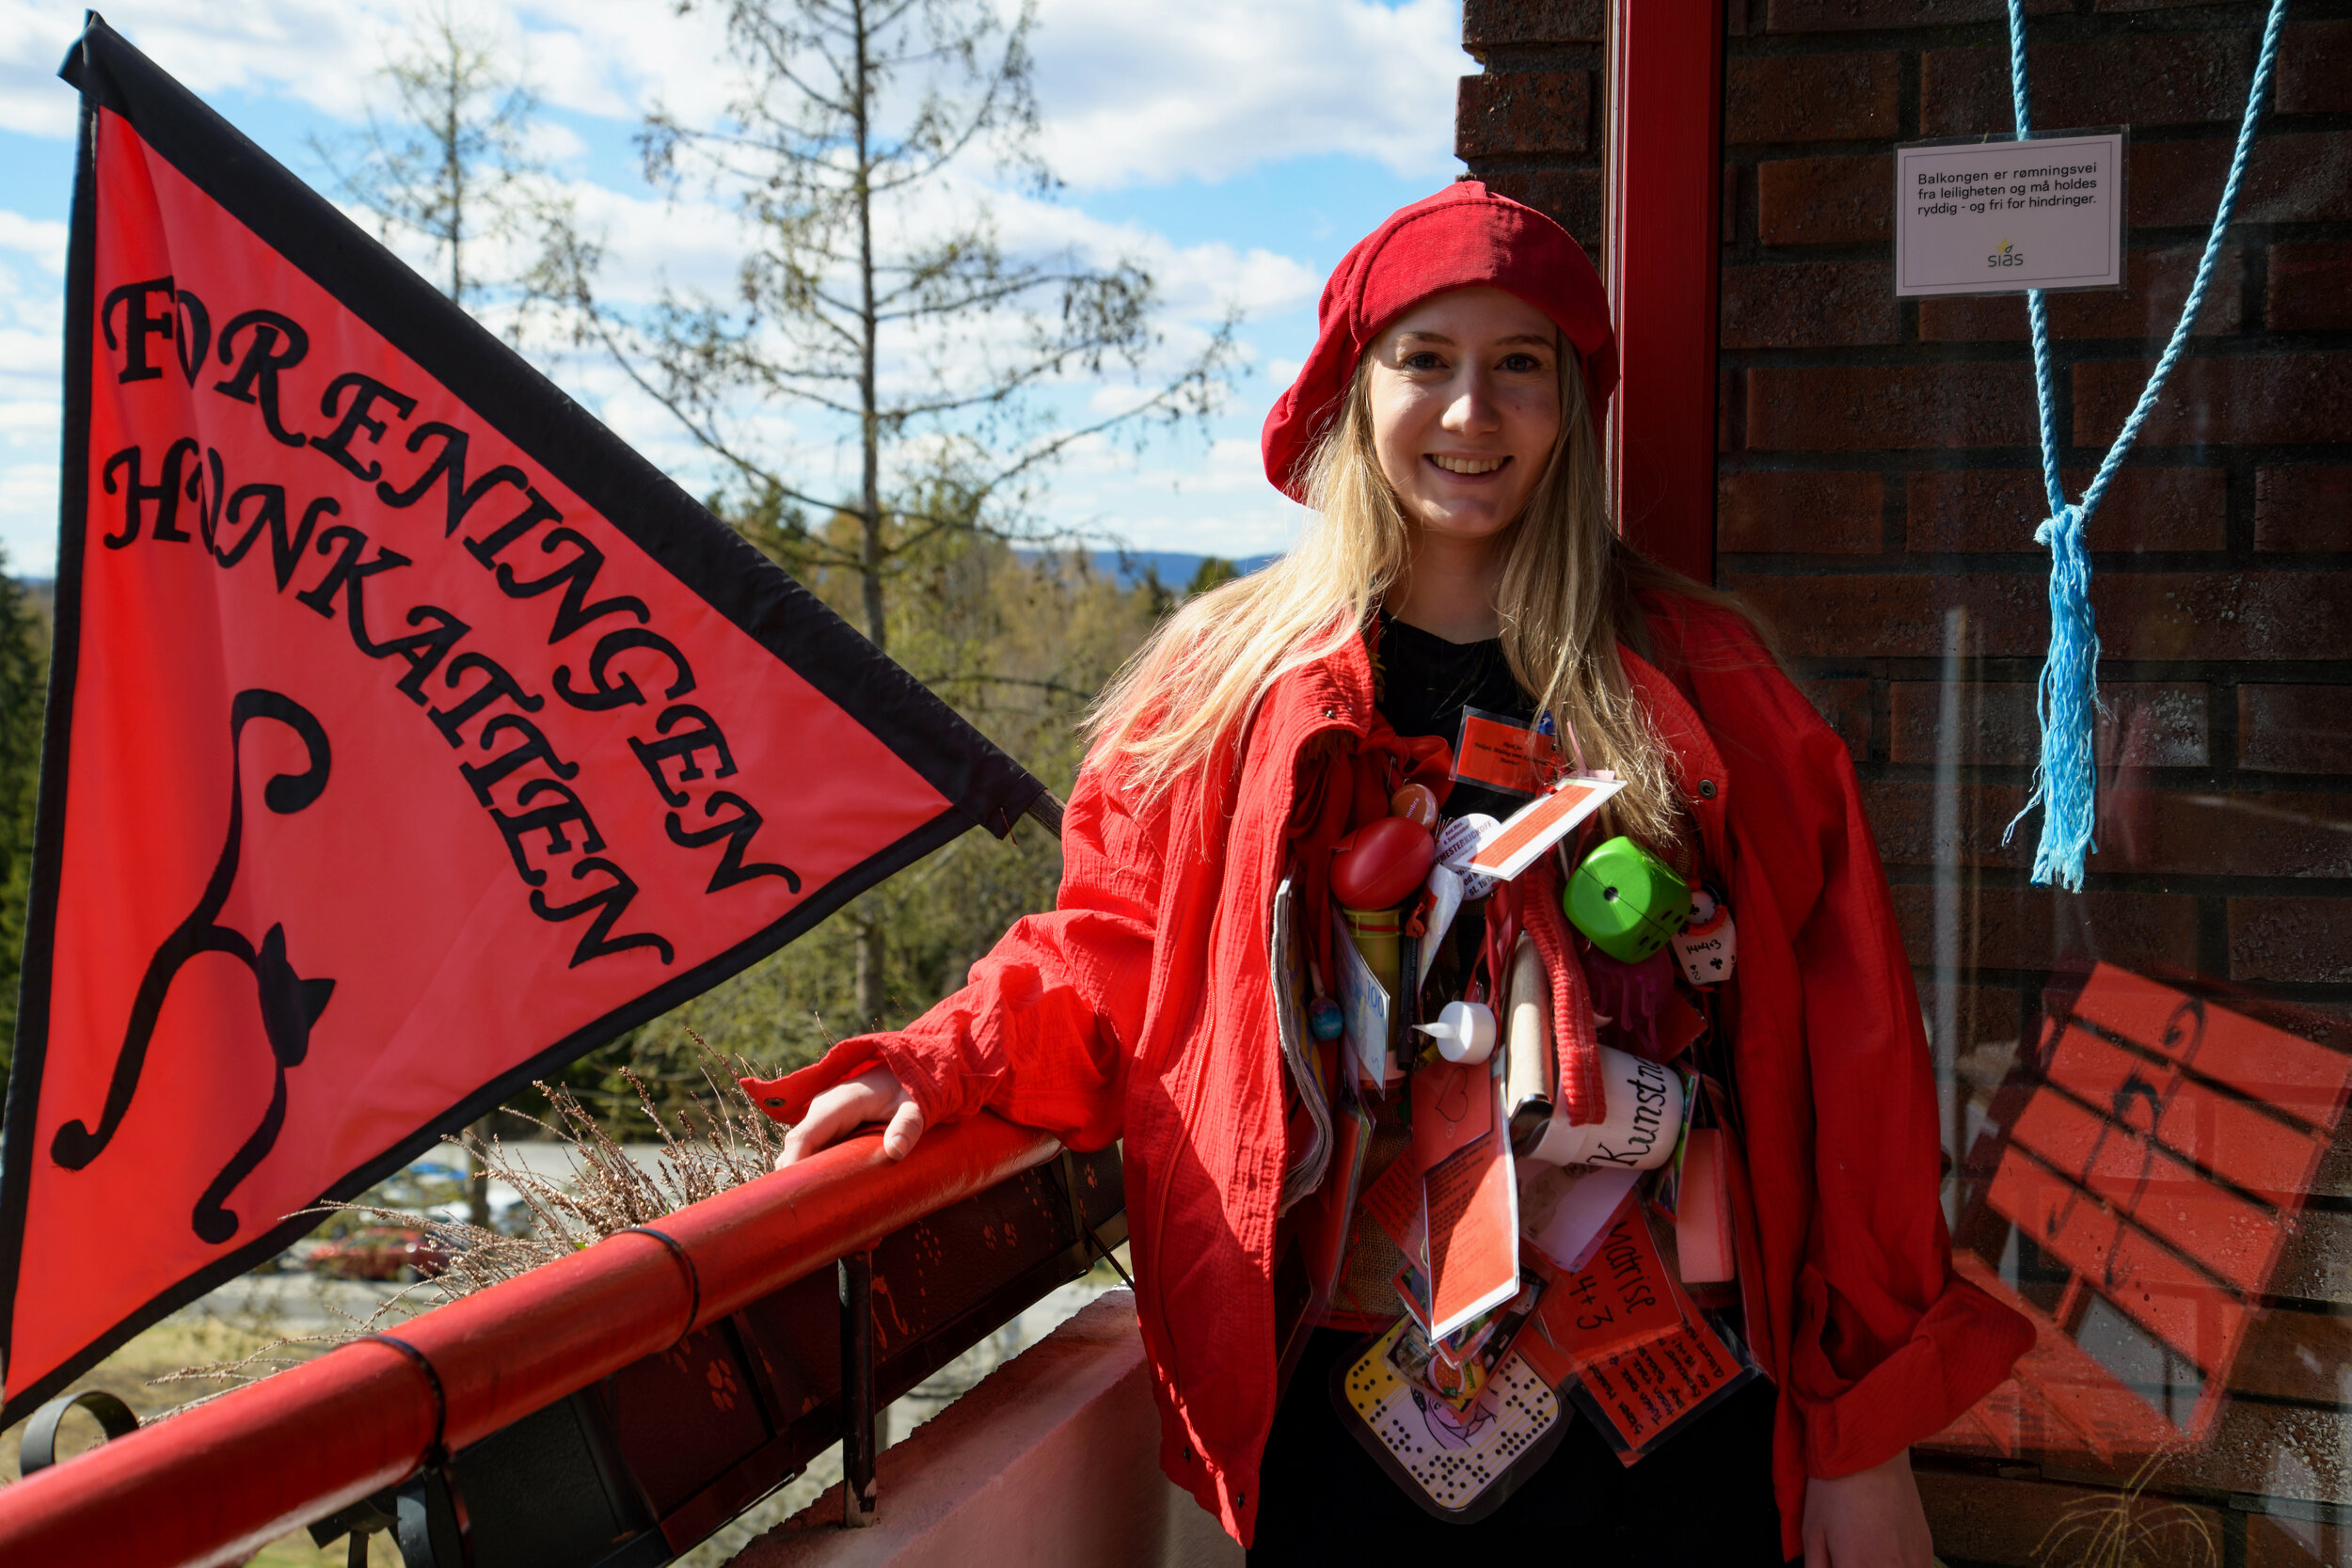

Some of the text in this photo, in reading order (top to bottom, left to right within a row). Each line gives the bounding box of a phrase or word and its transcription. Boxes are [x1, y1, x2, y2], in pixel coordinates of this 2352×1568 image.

[1918, 162, 2097, 185] Balkongen er rømningsvei
[1918, 178, 2097, 199] fra leiligheten og må holdes
[1917, 202, 1958, 217] ryddig
[1969, 201, 1985, 214] og
[1989, 198, 2004, 211] fri
[2007, 197, 2026, 209] for
[2028, 193, 2097, 209] hindringer.
[101, 276, 802, 895] FORENINGEN
[1366, 979, 1385, 1018] 100
